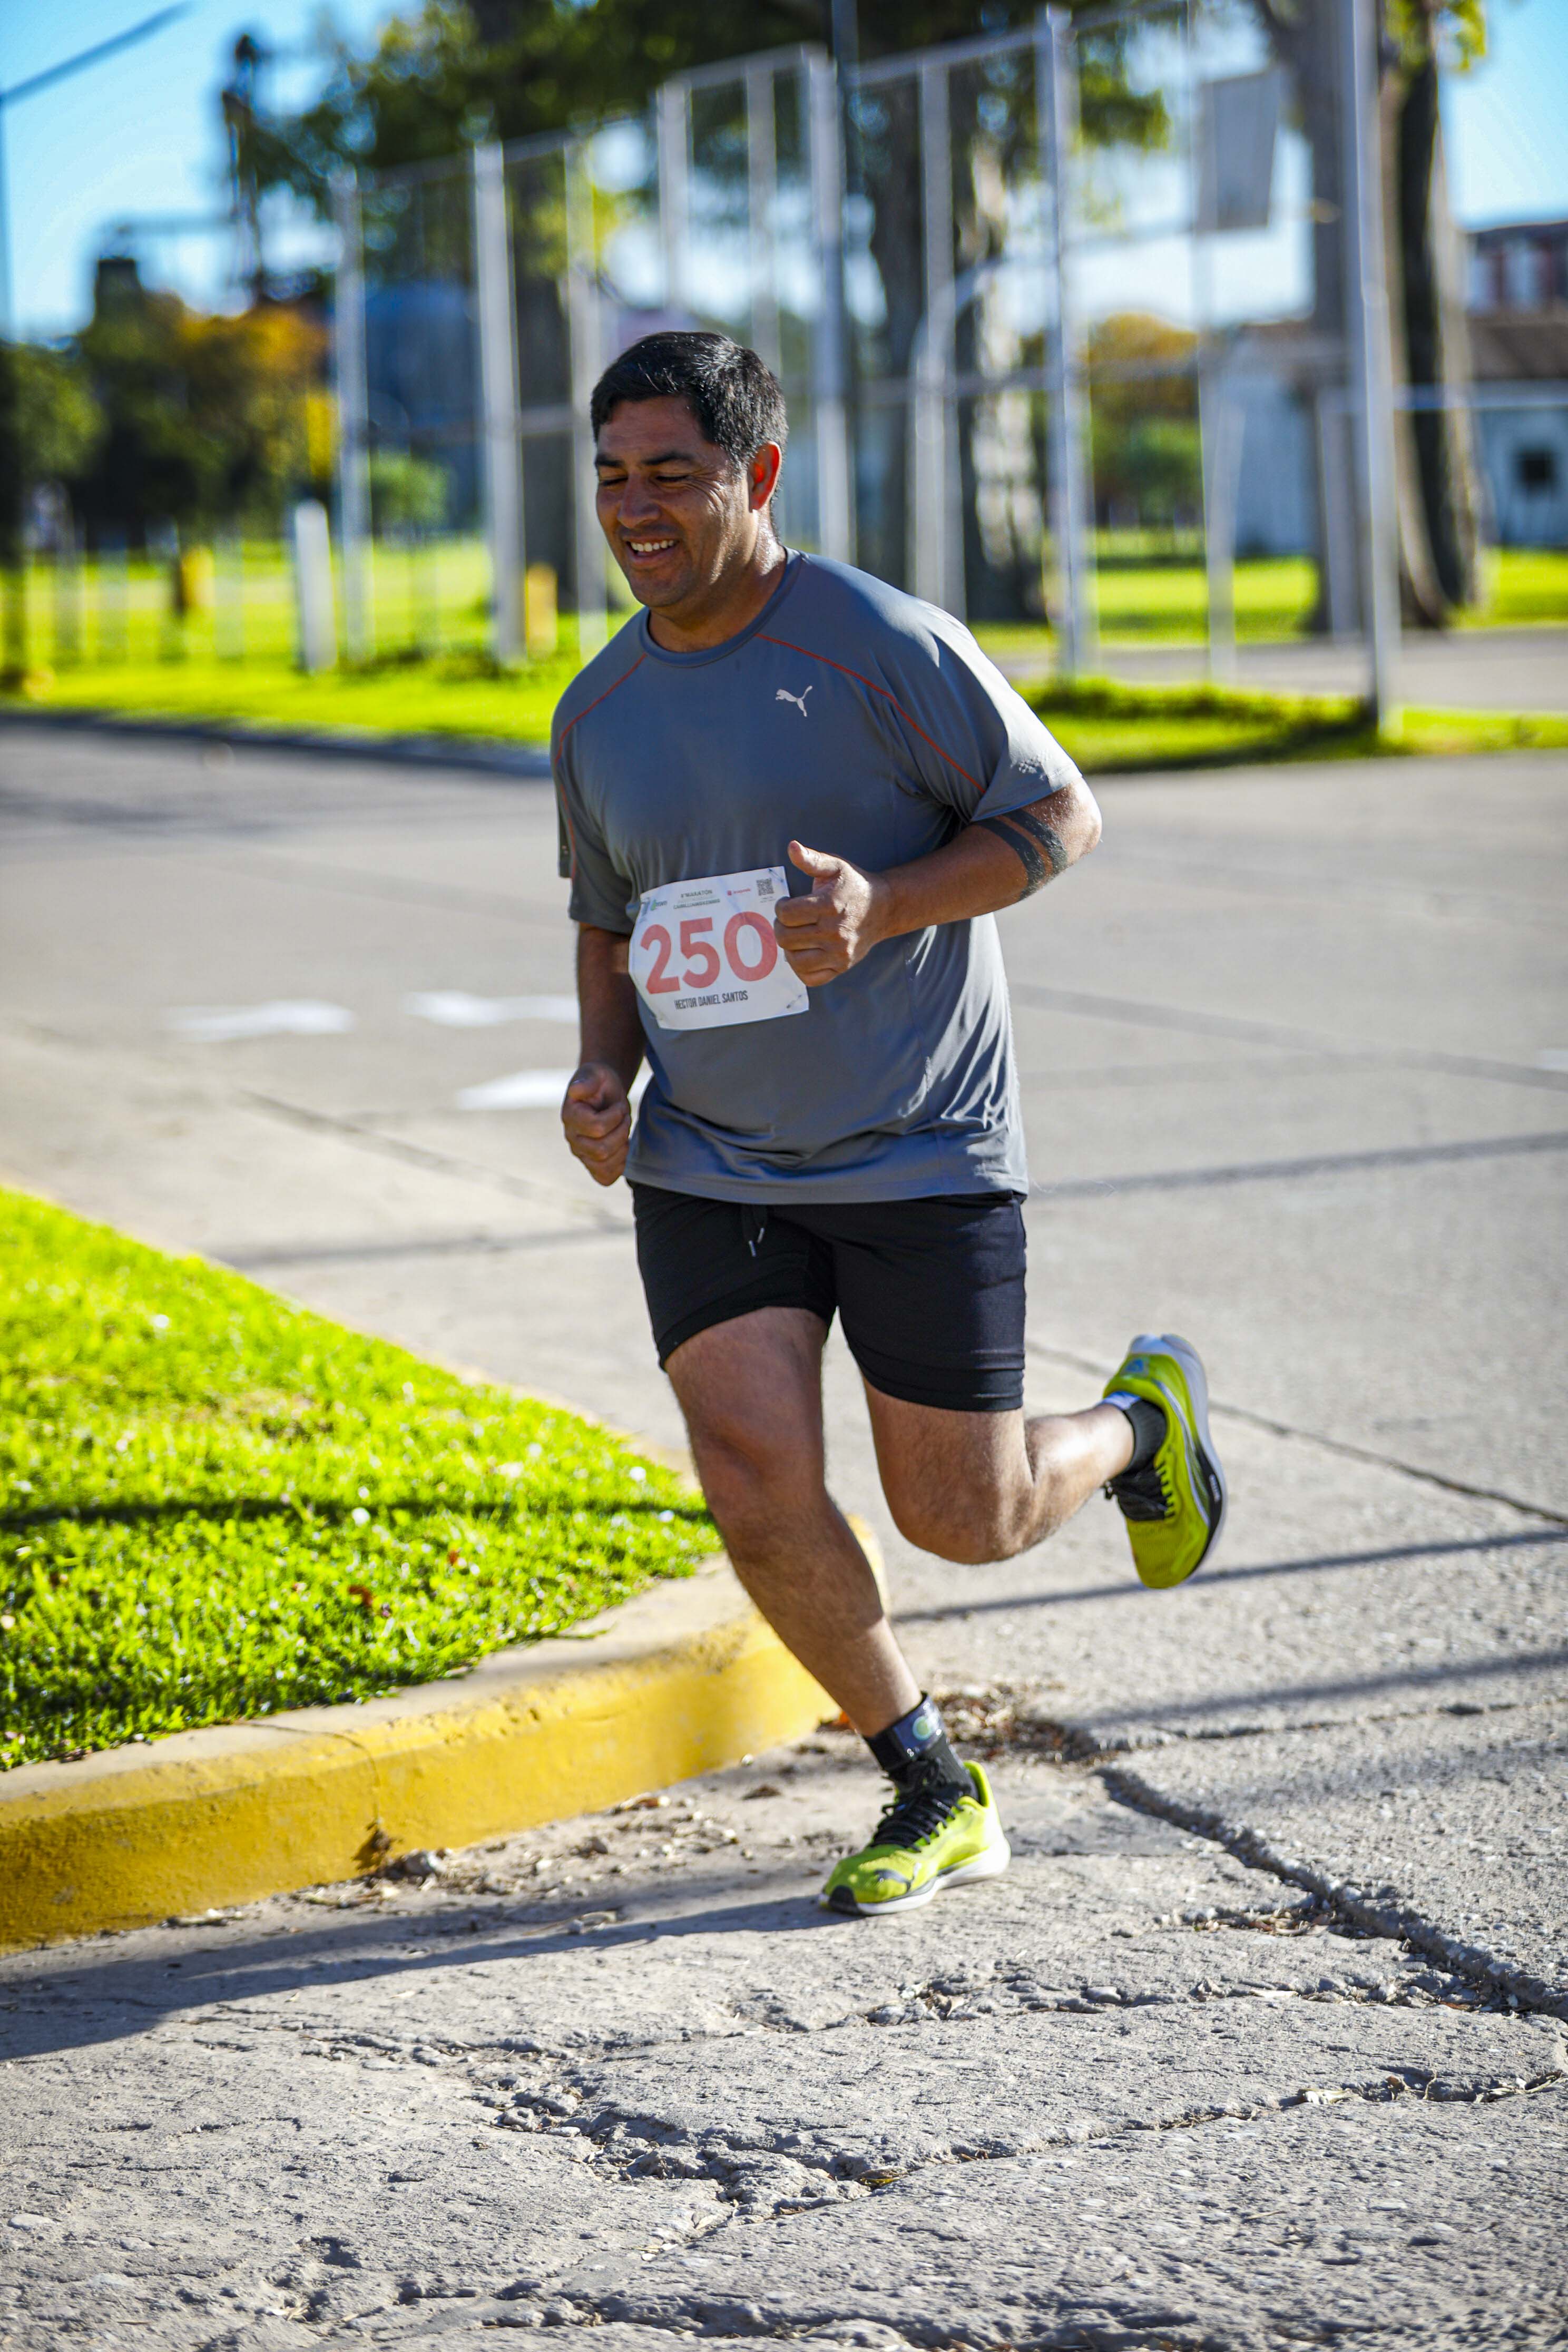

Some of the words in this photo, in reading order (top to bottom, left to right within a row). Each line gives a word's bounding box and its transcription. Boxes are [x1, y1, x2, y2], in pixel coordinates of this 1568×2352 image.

[640, 911, 778, 995] 250
[674, 997, 698, 1010] HECTOR
[698, 994, 721, 1006] DANIEL
[722, 990, 749, 1003] SANTOS
